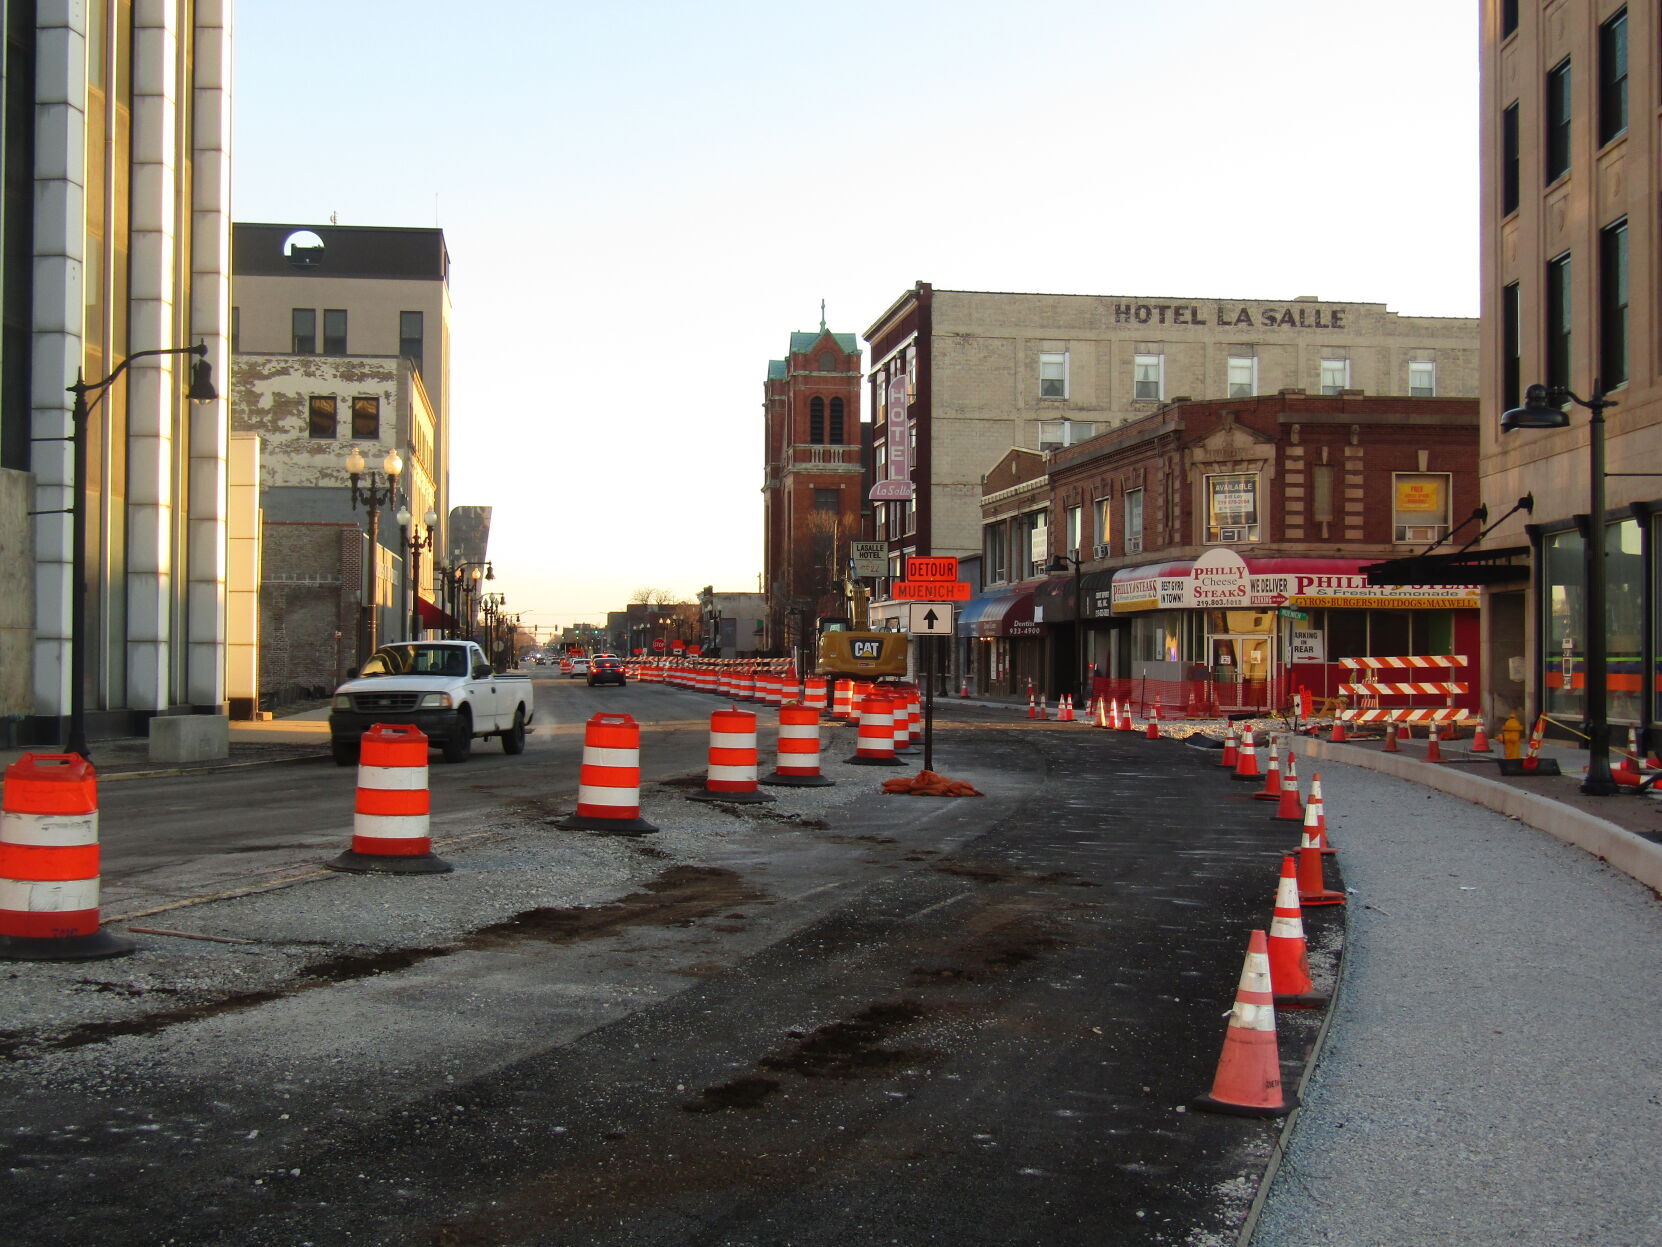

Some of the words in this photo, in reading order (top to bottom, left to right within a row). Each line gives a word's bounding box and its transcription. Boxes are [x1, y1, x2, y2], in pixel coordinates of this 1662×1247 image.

[1114, 303, 1207, 325] HOTEL
[1217, 306, 1254, 327] LA
[1261, 308, 1346, 329] SALLE
[890, 387, 905, 479] HOTEL
[1215, 483, 1253, 491] AVAILABLE
[856, 544, 884, 552] LASALLE
[860, 551, 881, 559] HOTEL
[910, 562, 954, 577] DETOUR
[1193, 566, 1246, 581] PHILLY
[1161, 580, 1171, 592] BEST
[1171, 580, 1184, 592] GYRO
[1202, 577, 1238, 587] Cheese
[1250, 578, 1260, 593] WE
[1261, 577, 1288, 593] DELIVER
[1295, 575, 1386, 596] PHILL
[898, 585, 954, 598] MUENICH
[1112, 583, 1133, 602] PHILLY
[1136, 579, 1158, 598] STEAKS
[1193, 584, 1247, 599] STEAKS
[1317, 588, 1328, 596] &
[1380, 589, 1459, 597] Lemonade
[1160, 593, 1166, 604] IN
[1166, 593, 1184, 604] TOWN!
[1331, 598, 1373, 607] BURGERS
[1377, 598, 1424, 608] HOTDOGS
[1426, 599, 1474, 608] MAXWELL
[1009, 627, 1040, 635] 933-4900
[1294, 631, 1318, 640] ARKING
[854, 641, 879, 657] CAT
[1294, 645, 1314, 653] REAR
